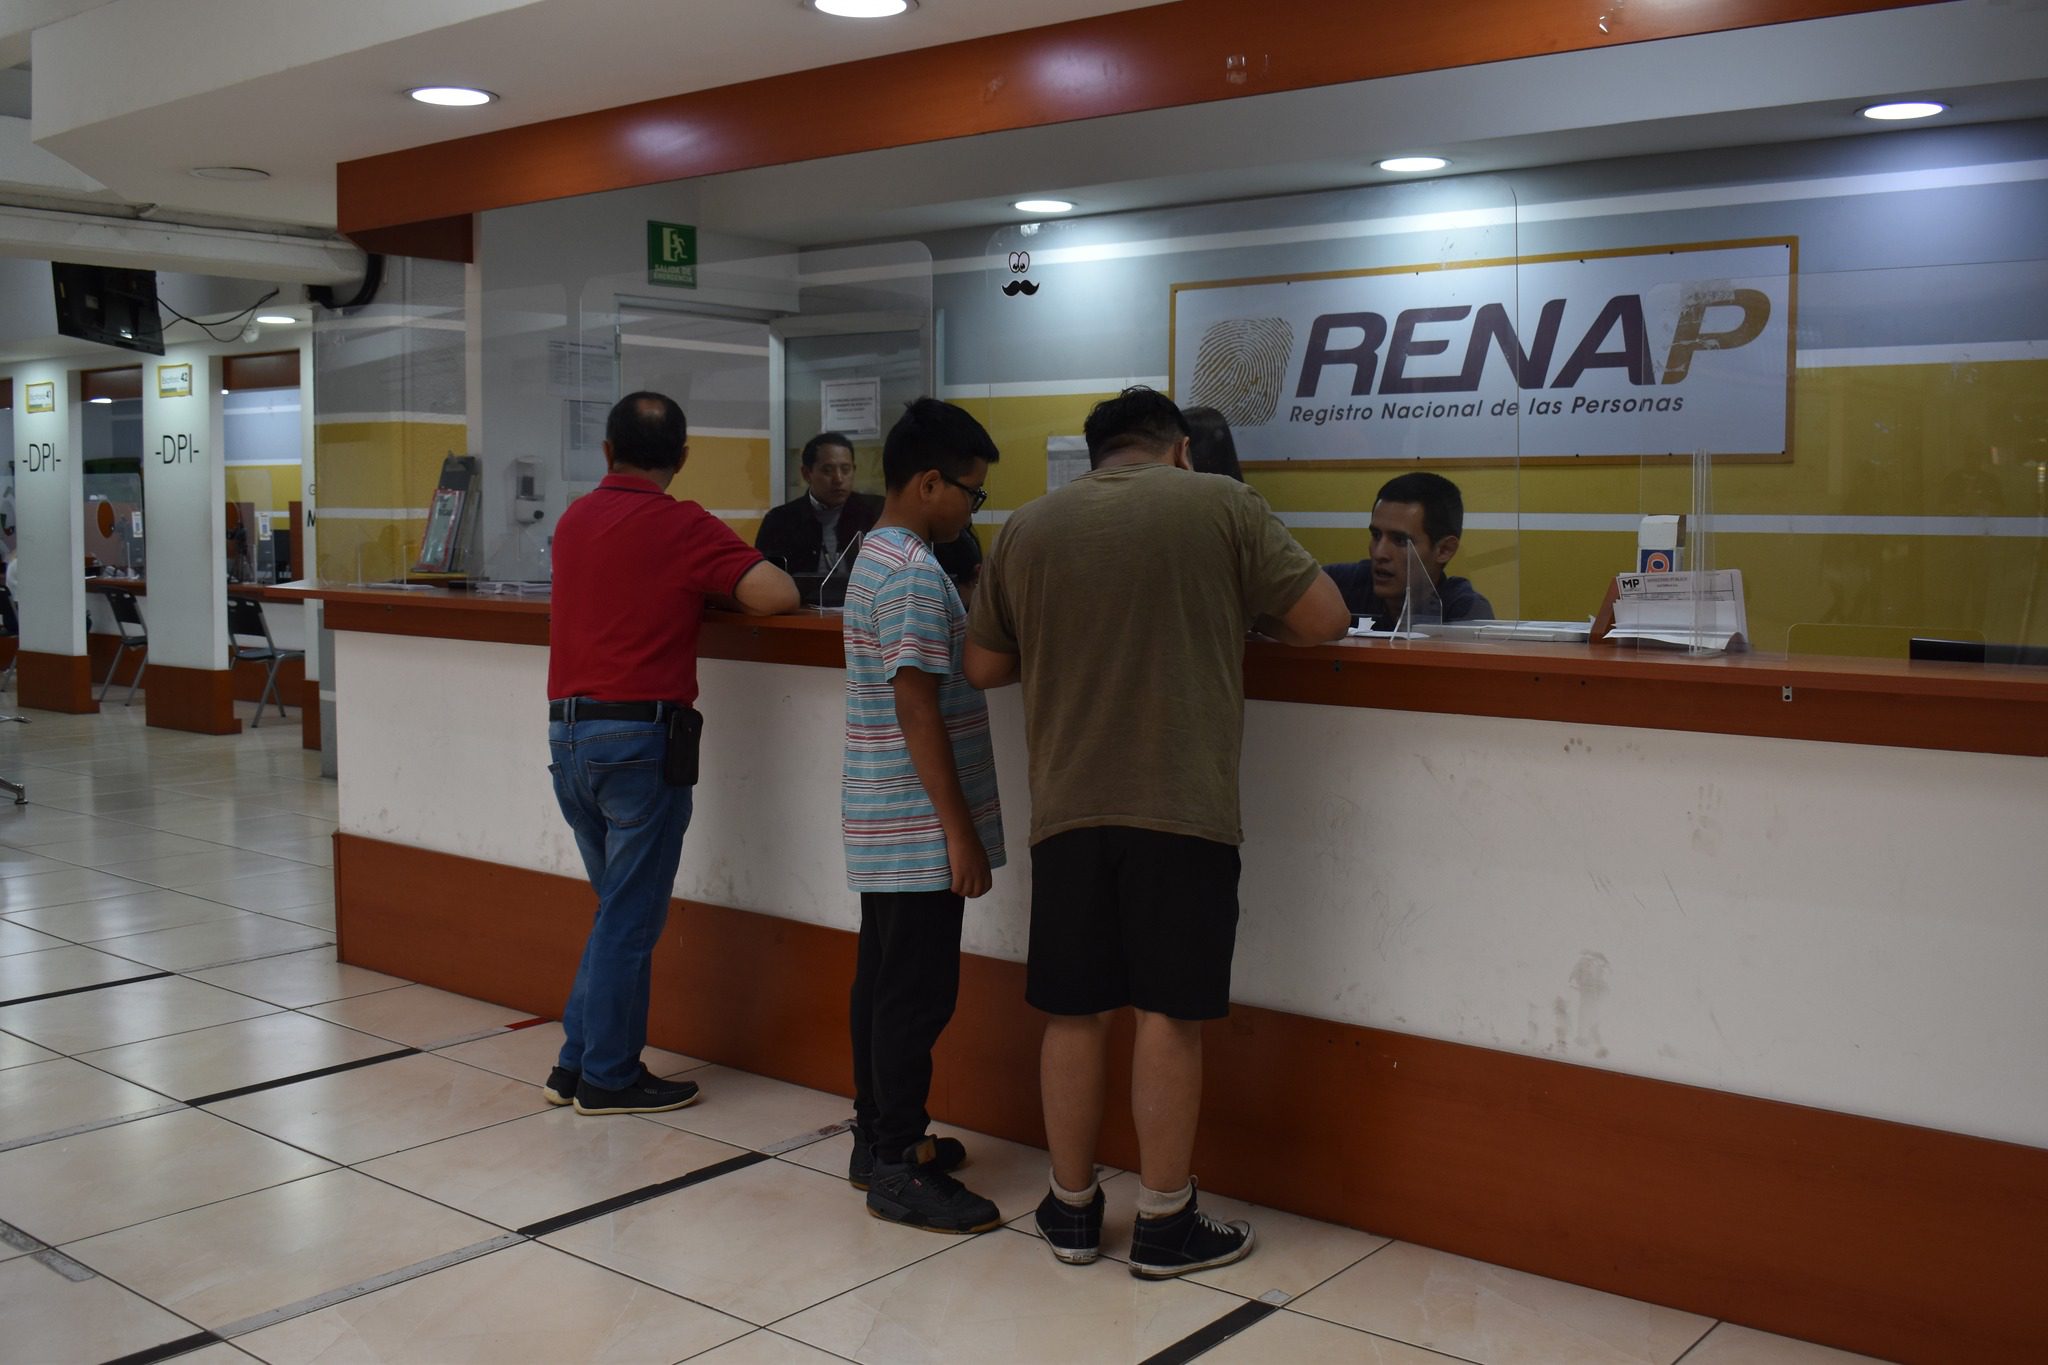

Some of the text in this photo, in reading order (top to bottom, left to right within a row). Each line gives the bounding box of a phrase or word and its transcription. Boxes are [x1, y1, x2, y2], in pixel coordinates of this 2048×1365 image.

[655, 264, 680, 273] SALIDA
[1295, 288, 1771, 398] RENAP
[1290, 396, 1684, 426] Registro Nacional de las Personas
[1622, 579, 1640, 589] MP
